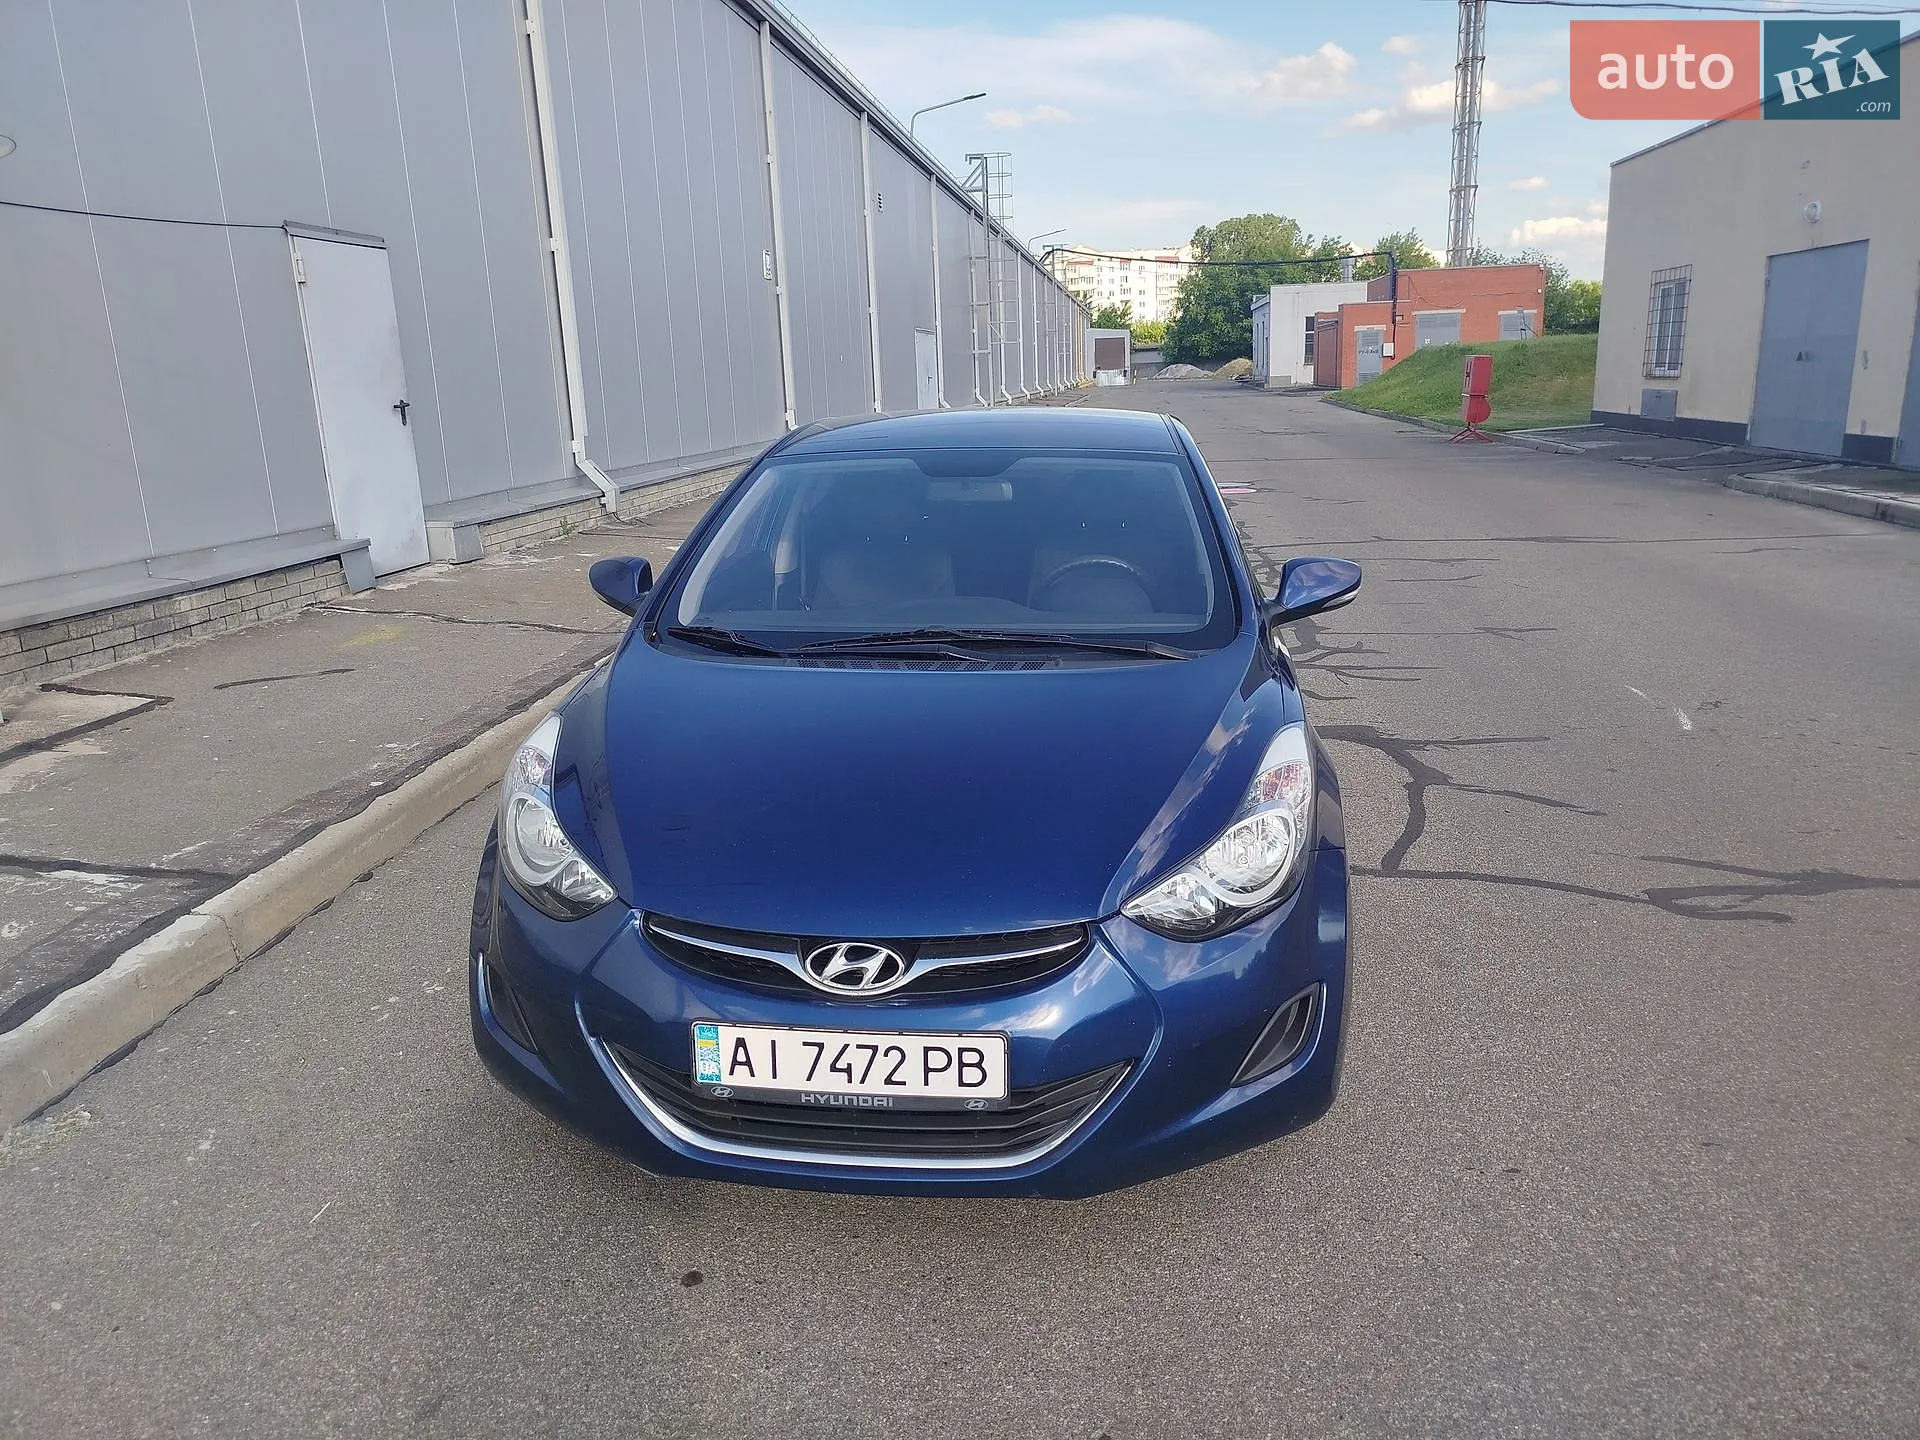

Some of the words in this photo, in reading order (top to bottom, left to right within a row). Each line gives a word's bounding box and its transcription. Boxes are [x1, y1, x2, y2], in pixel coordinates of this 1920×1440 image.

[728, 1036, 778, 1080] AI
[802, 1041, 907, 1086] 7472
[923, 1046, 988, 1088] PB
[801, 1093, 893, 1107] HYUNDAI
